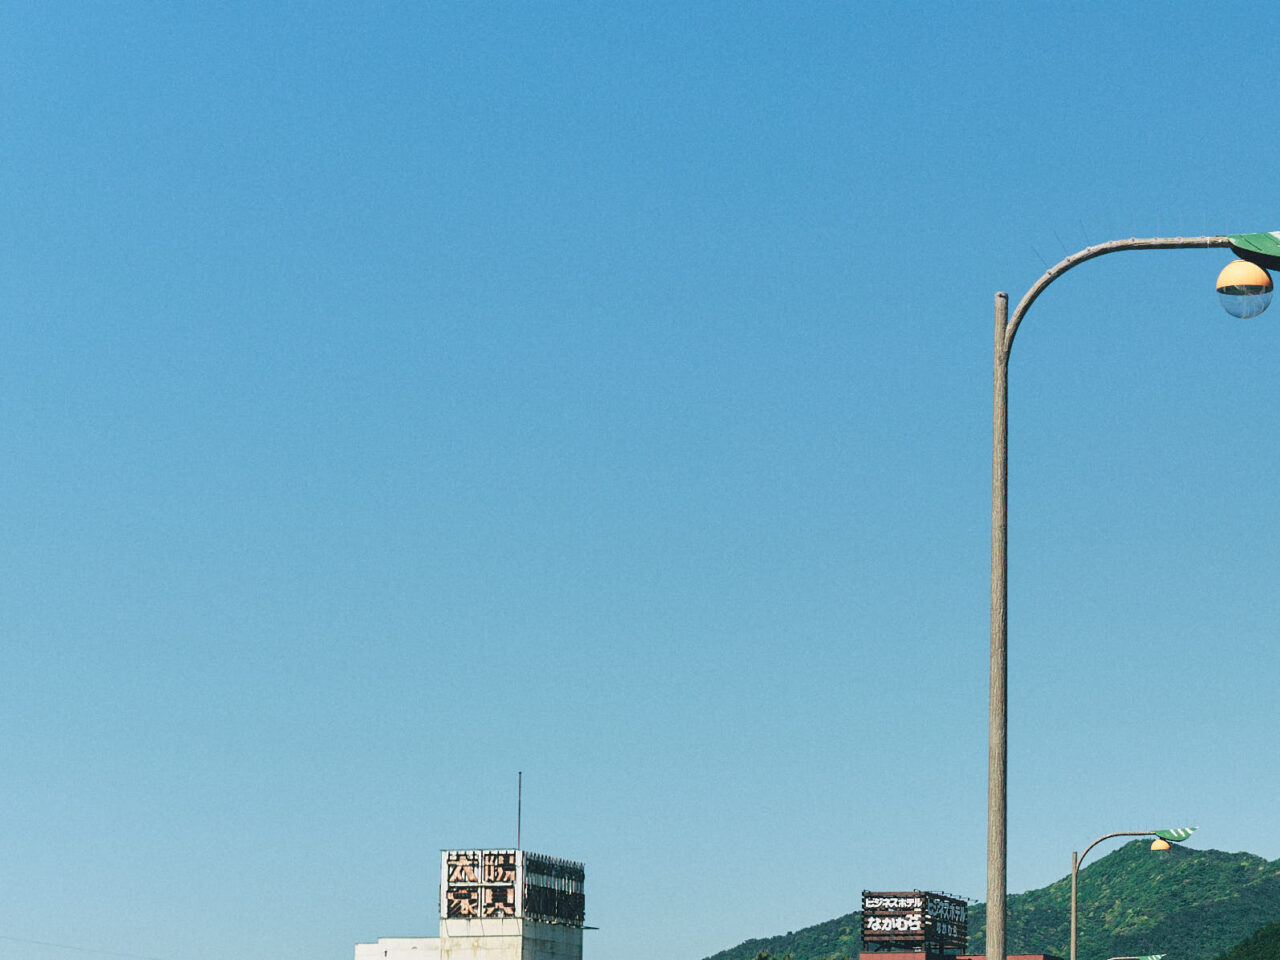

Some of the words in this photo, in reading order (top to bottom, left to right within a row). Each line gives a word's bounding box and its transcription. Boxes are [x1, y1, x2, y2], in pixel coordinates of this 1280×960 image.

[447, 888, 516, 915] 家具
[865, 897, 922, 908] ビジネスホテル
[867, 914, 921, 931] なかむら
